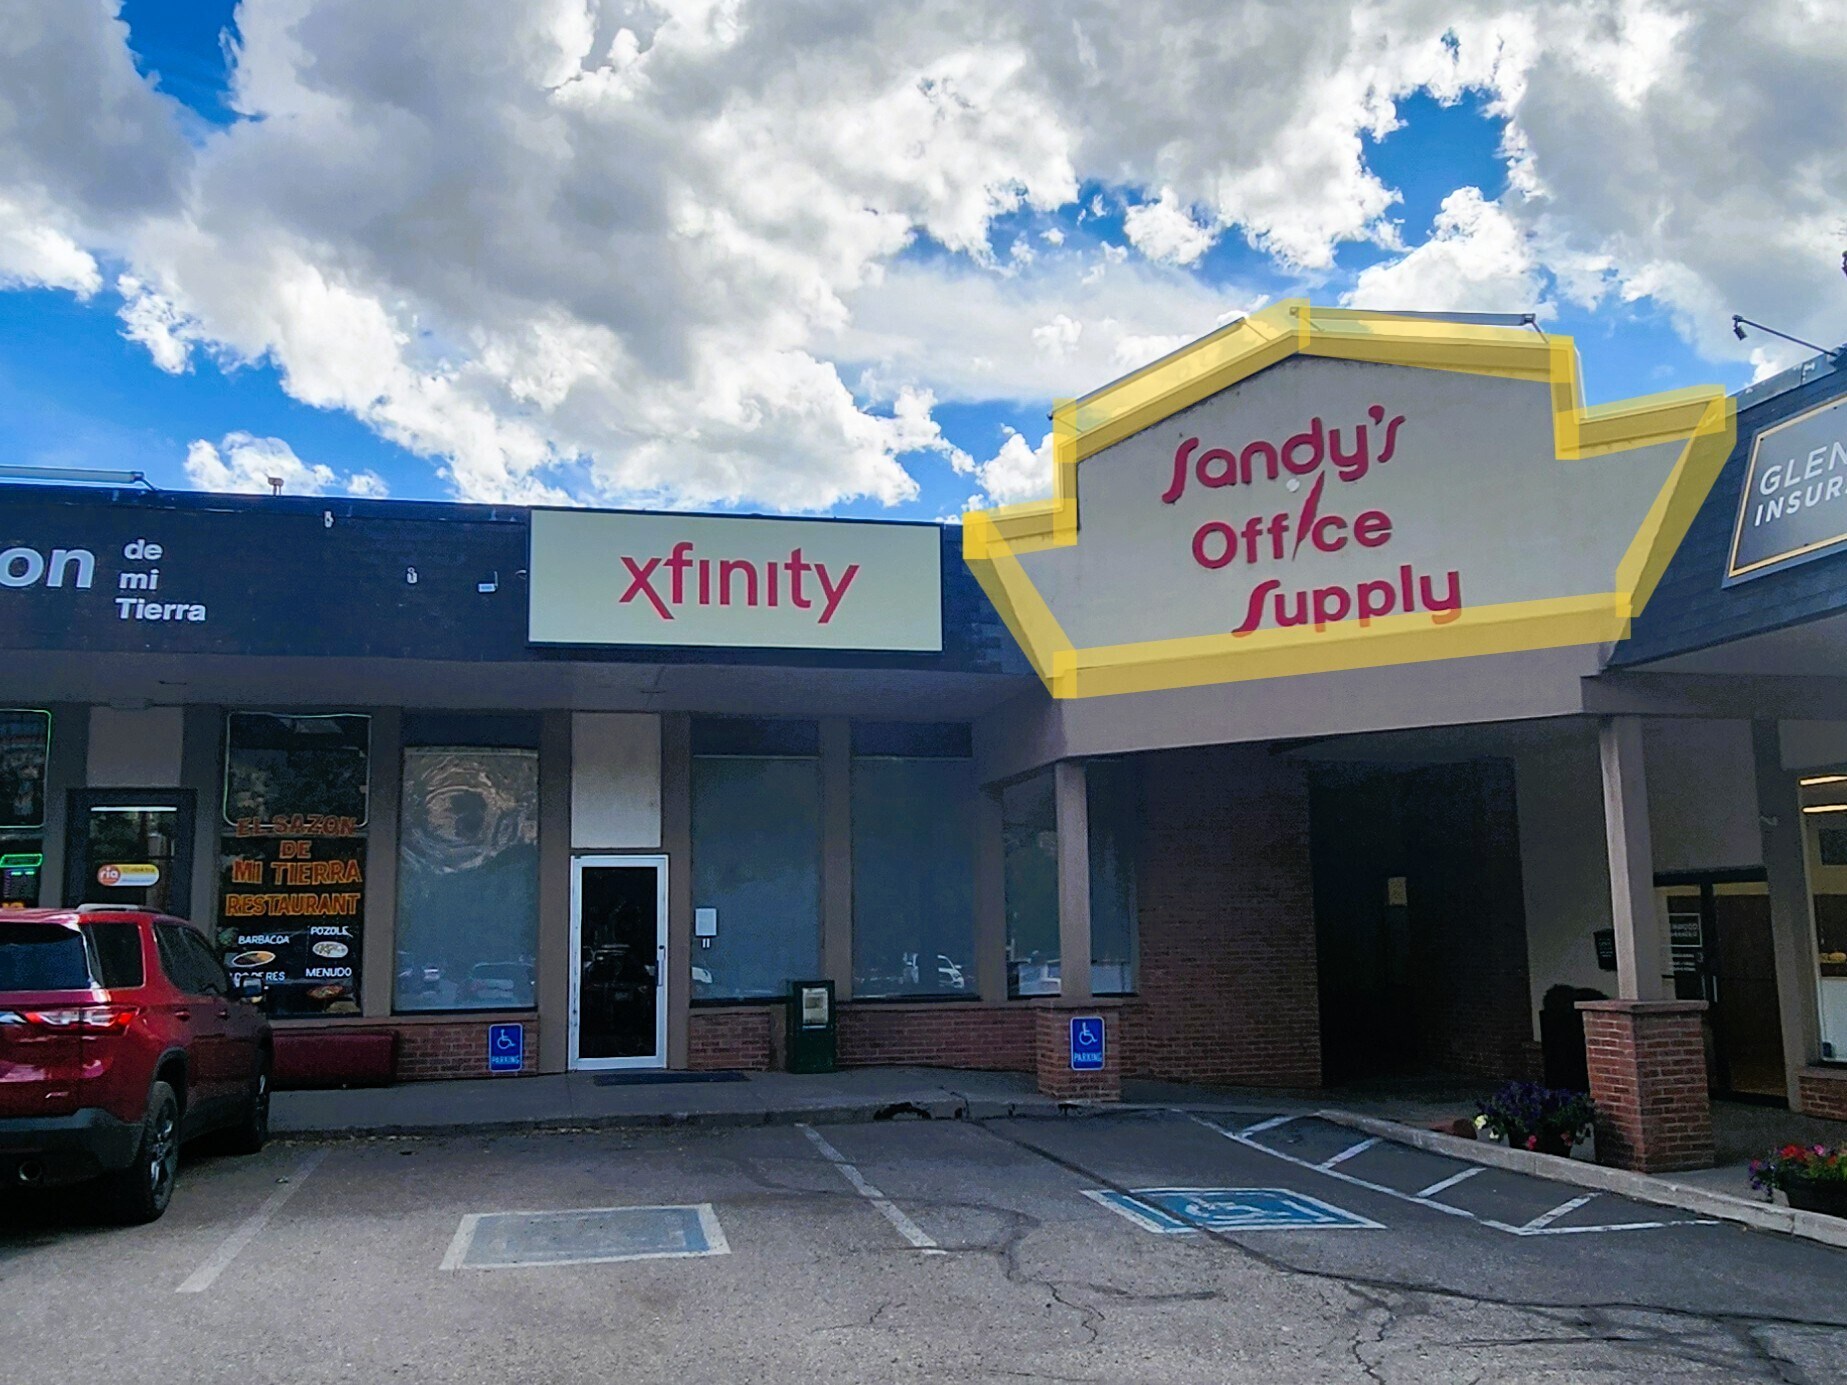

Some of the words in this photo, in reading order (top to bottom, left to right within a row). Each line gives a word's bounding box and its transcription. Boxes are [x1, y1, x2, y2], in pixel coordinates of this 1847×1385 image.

[1161, 404, 1407, 504] Sandy's
[1754, 475, 1847, 527] INSUR
[1192, 473, 1393, 570] Office
[124, 539, 163, 560] de
[119, 568, 160, 590] mi
[619, 541, 860, 624] xfinity
[115, 597, 206, 621] Tierra
[1230, 564, 1462, 638] Supply
[236, 817, 266, 838] EL
[272, 813, 357, 836] SAZON
[279, 840, 312, 859] DE
[232, 859, 263, 884] MI
[271, 859, 363, 885] TIERRA
[225, 893, 361, 916] RESTAURANT
[237, 935, 290, 945] BARBACOA
[310, 926, 349, 936] POZOLE
[266, 971, 286, 981] RES
[305, 967, 352, 978] MENUDO
[1073, 1052, 1102, 1062] PARKING
